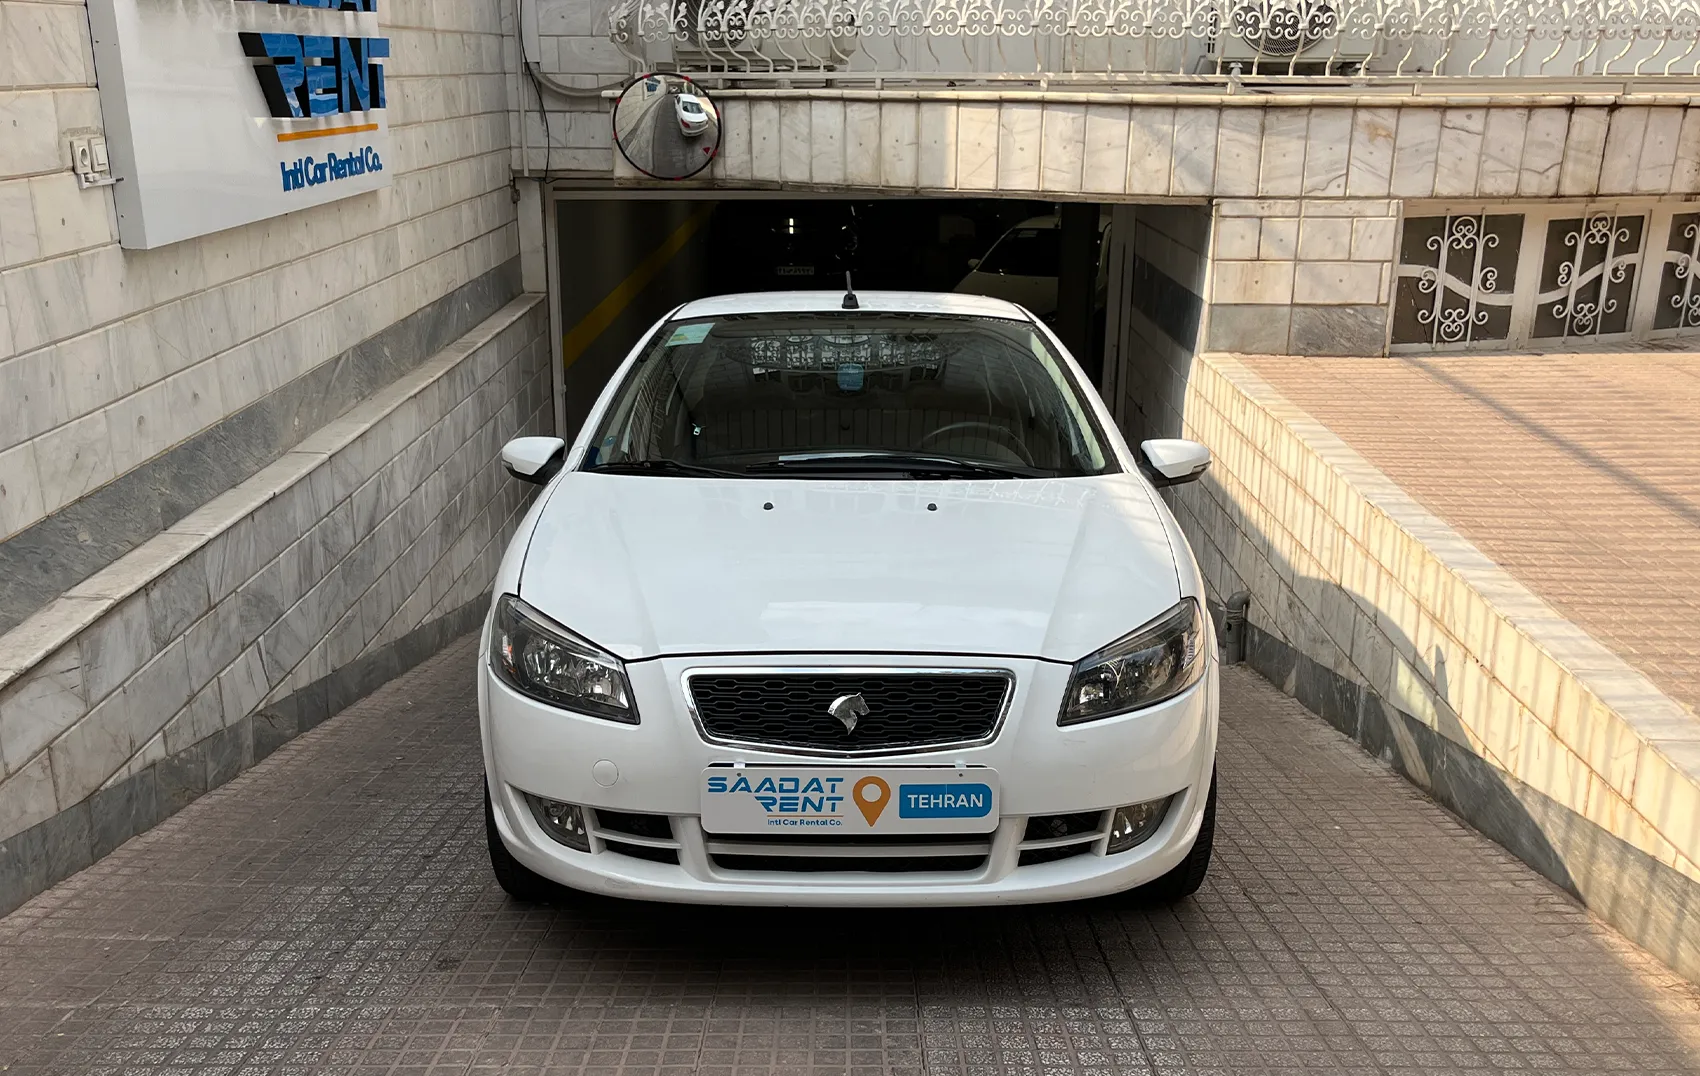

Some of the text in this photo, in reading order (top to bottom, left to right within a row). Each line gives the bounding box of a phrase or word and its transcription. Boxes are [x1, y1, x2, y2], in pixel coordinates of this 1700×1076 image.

[239, 32, 389, 118] RENT
[304, 156, 328, 186] Car
[327, 148, 365, 181] Rental
[364, 145, 383, 173] Co.
[707, 776, 844, 793] SAADAT
[754, 796, 844, 812] RENT
[907, 793, 984, 808] TEHRAN
[782, 818, 798, 826] Car
[799, 818, 828, 826] Rental
[829, 818, 843, 826] Co.
